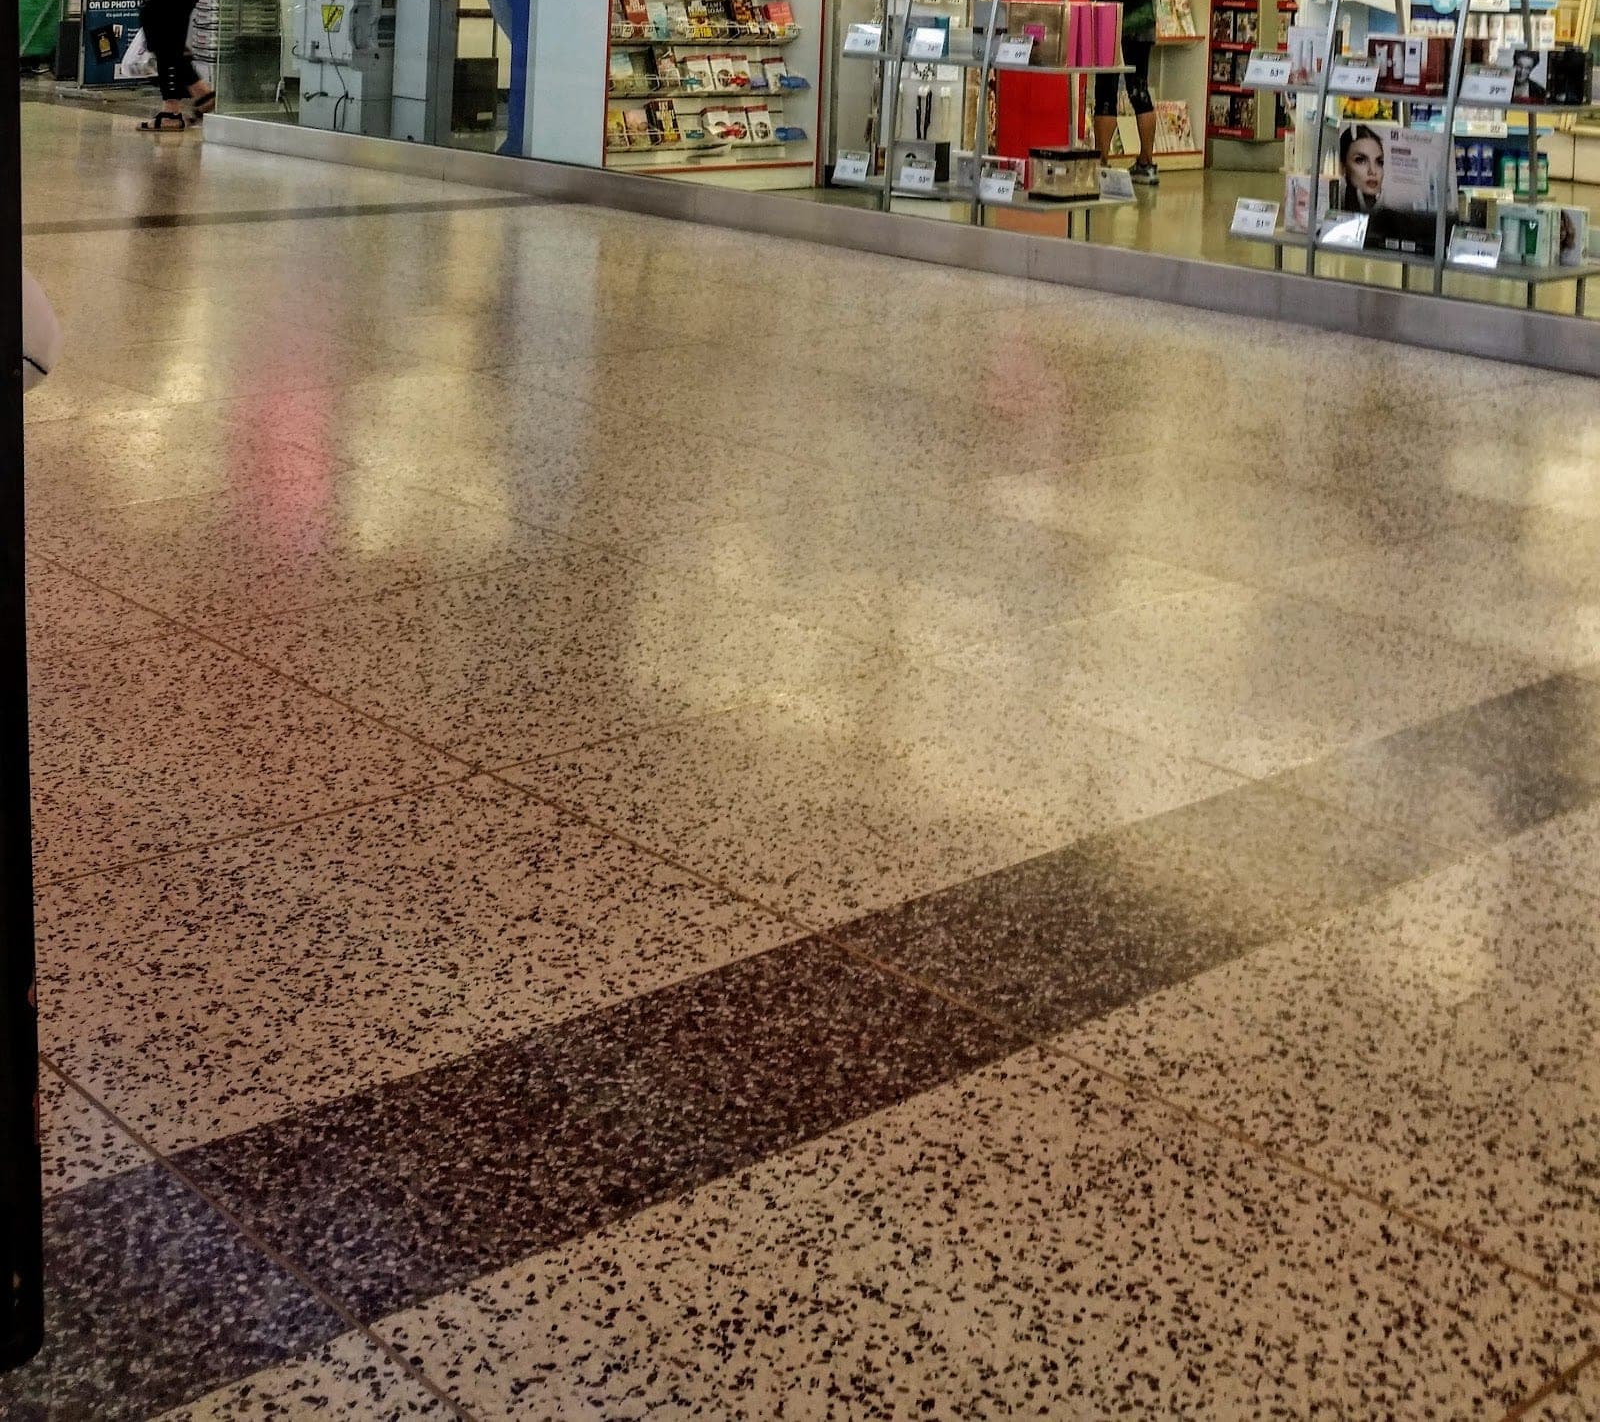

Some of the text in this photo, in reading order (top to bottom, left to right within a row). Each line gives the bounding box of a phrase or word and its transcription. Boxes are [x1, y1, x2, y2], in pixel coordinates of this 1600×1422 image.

[89, 1, 101, 9] OR
[102, 1, 110, 9] ID
[111, 0, 136, 9] PHOTO
